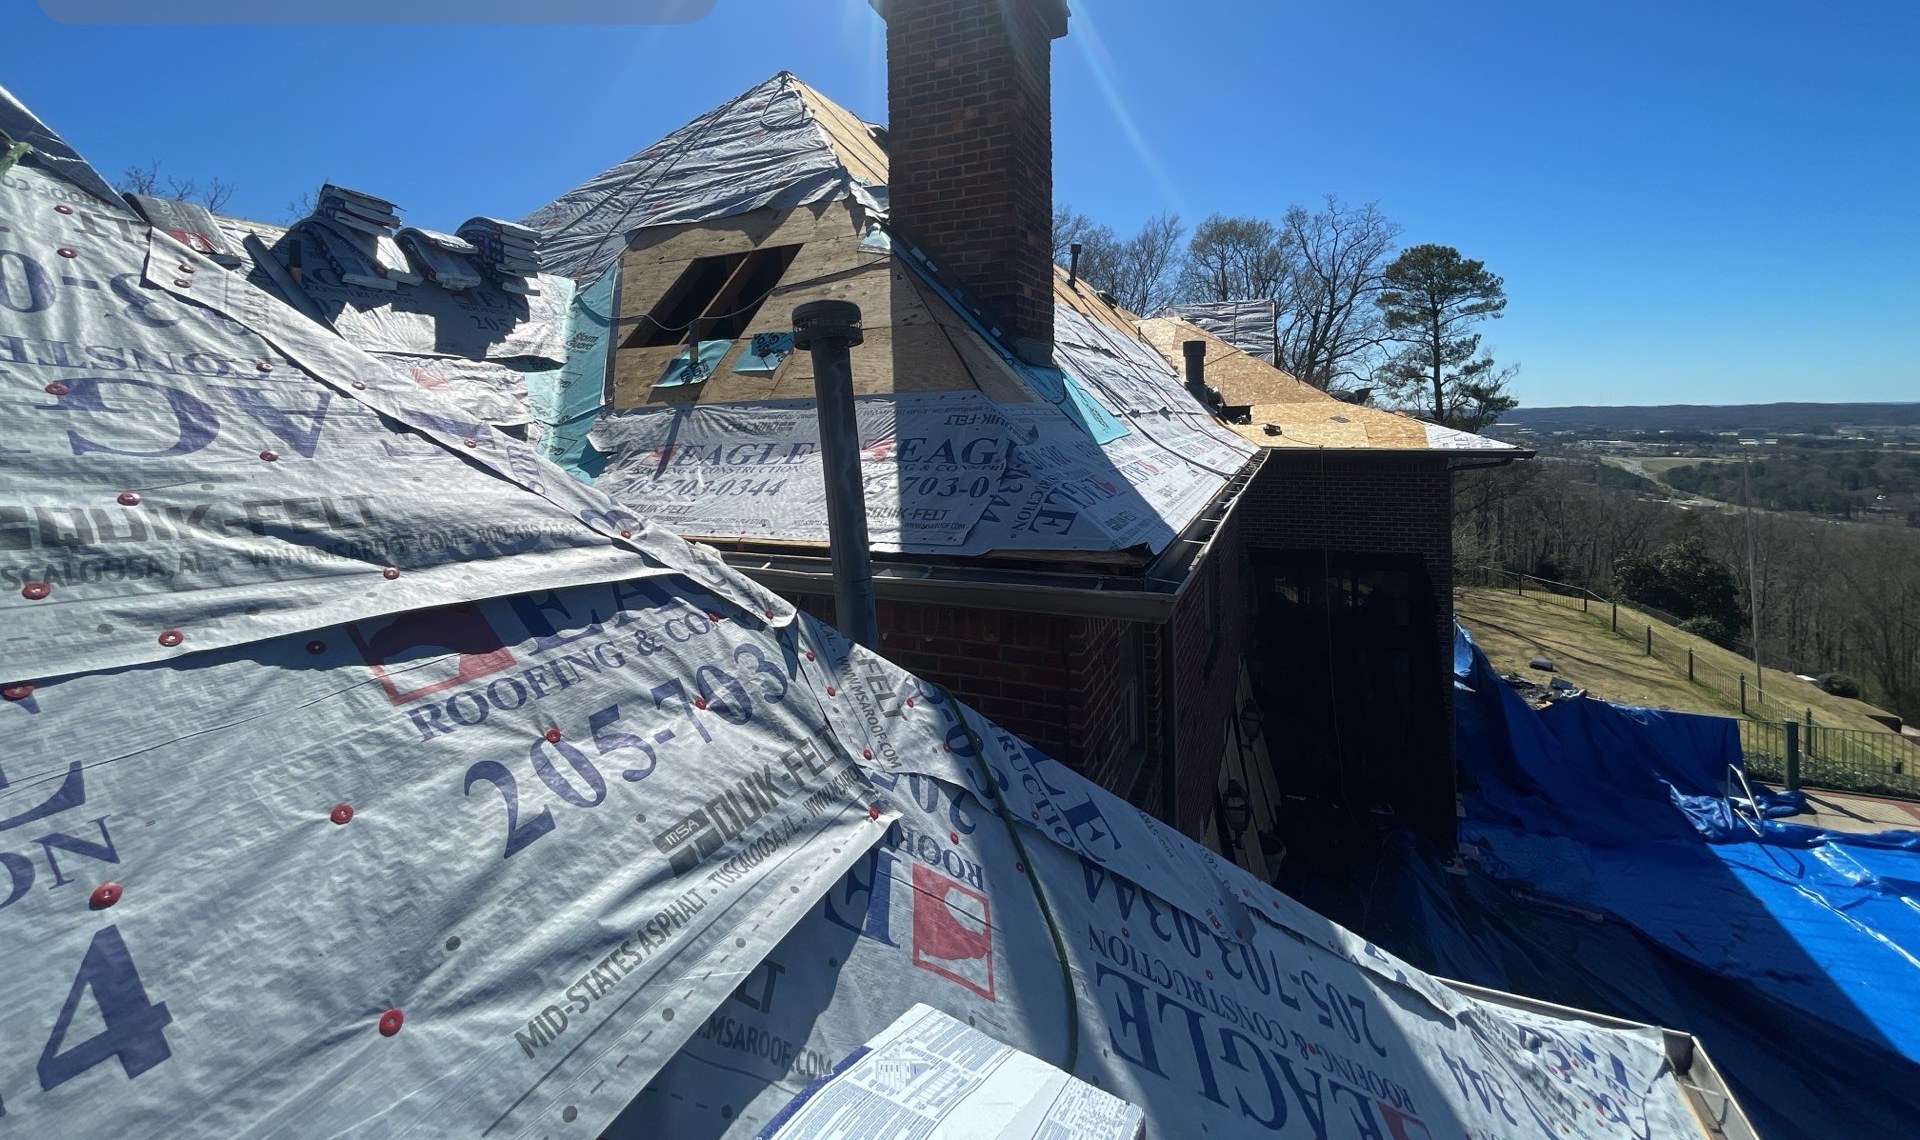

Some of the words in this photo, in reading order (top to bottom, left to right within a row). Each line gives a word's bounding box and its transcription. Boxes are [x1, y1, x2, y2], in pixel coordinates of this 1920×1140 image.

[565, 341, 598, 351] Guard
[575, 331, 599, 342] Storm
[611, 478, 787, 497] 205-703-0344
[673, 443, 815, 466] EAGLE
[407, 641, 627, 744] ROOFING
[633, 628, 664, 656] &
[837, 654, 903, 770] WWW.MSAROOF.COM
[704, 725, 842, 843] QUIK-FELT
[664, 818, 700, 846] MSA
[513, 939, 643, 1060] MID-STATES
[636, 887, 708, 955] ASPHALT
[1089, 923, 1289, 1049] CONSTRUCTION
[1095, 962, 1384, 1140] EAGLE
[1319, 1042, 1417, 1114] ROOFING
